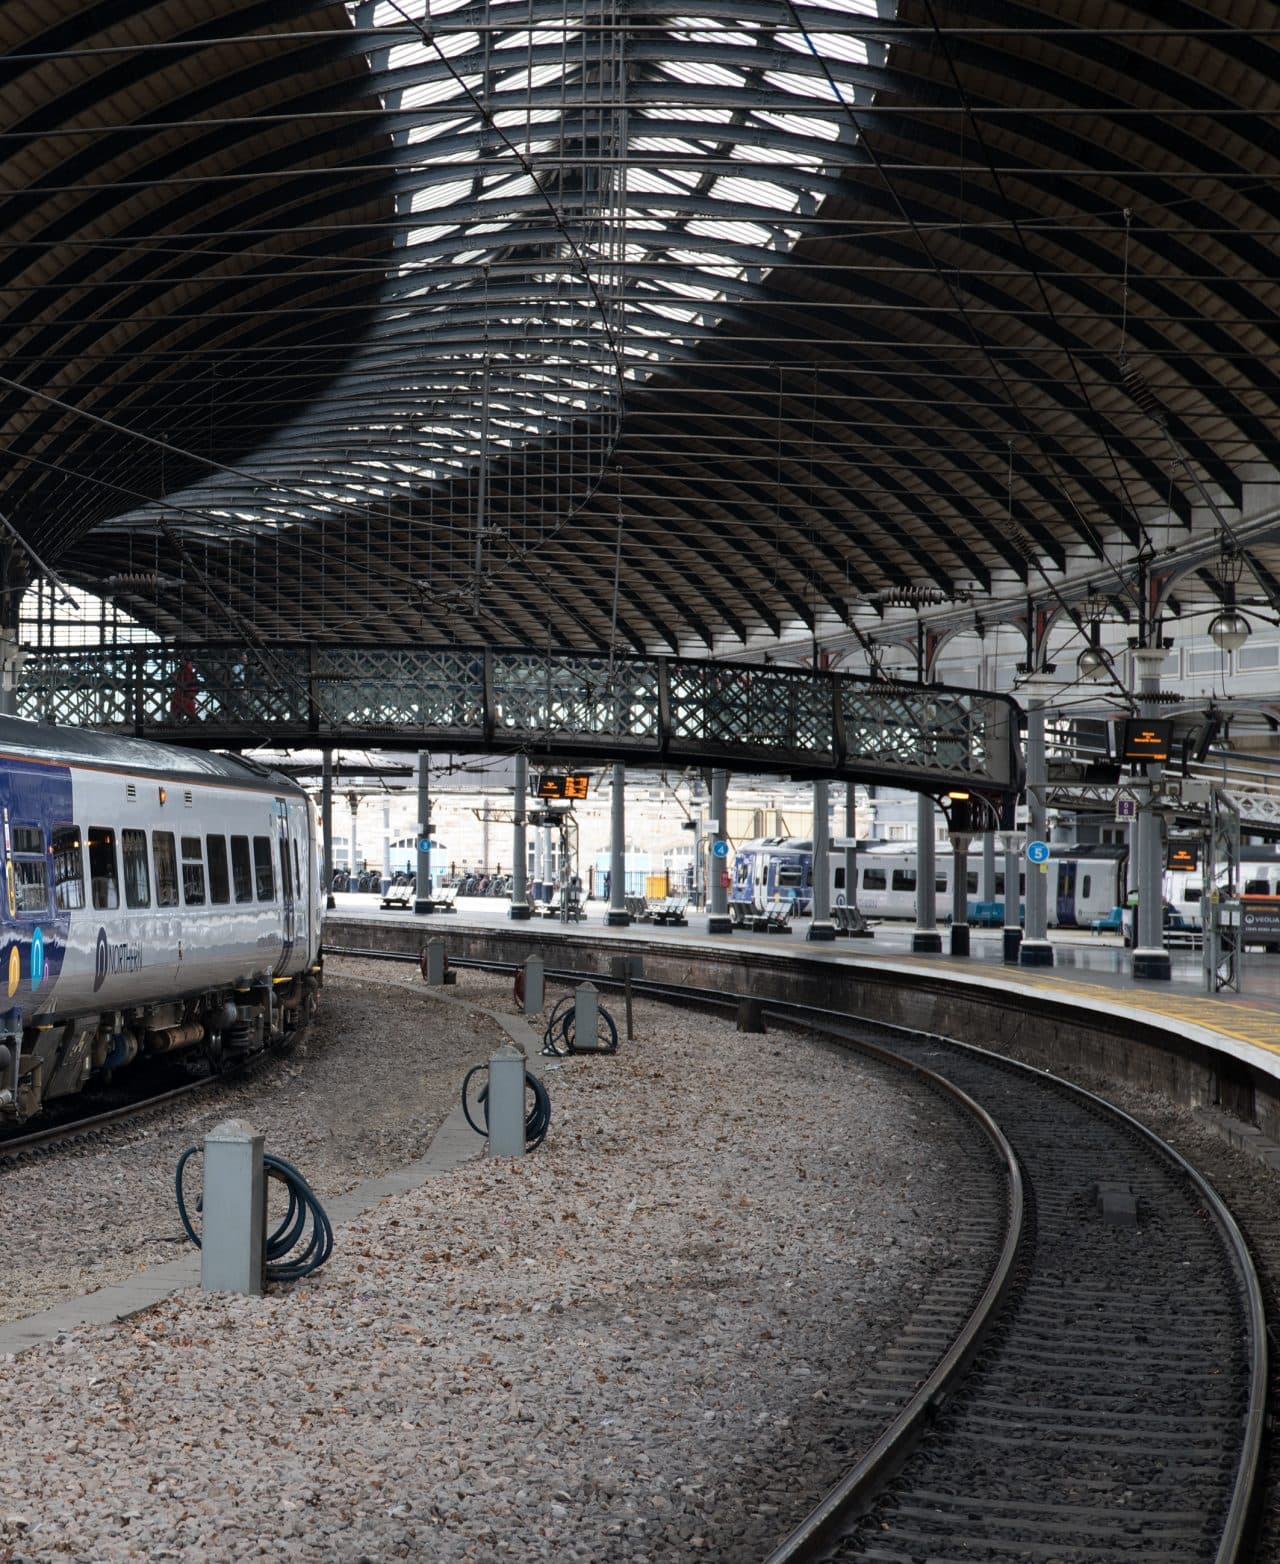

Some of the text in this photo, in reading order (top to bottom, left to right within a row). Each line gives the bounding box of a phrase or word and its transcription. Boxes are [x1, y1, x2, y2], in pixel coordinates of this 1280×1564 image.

[717, 845, 724, 854] 4
[1034, 848, 1043, 859] 5
[108, 940, 143, 977] NORTHERN
